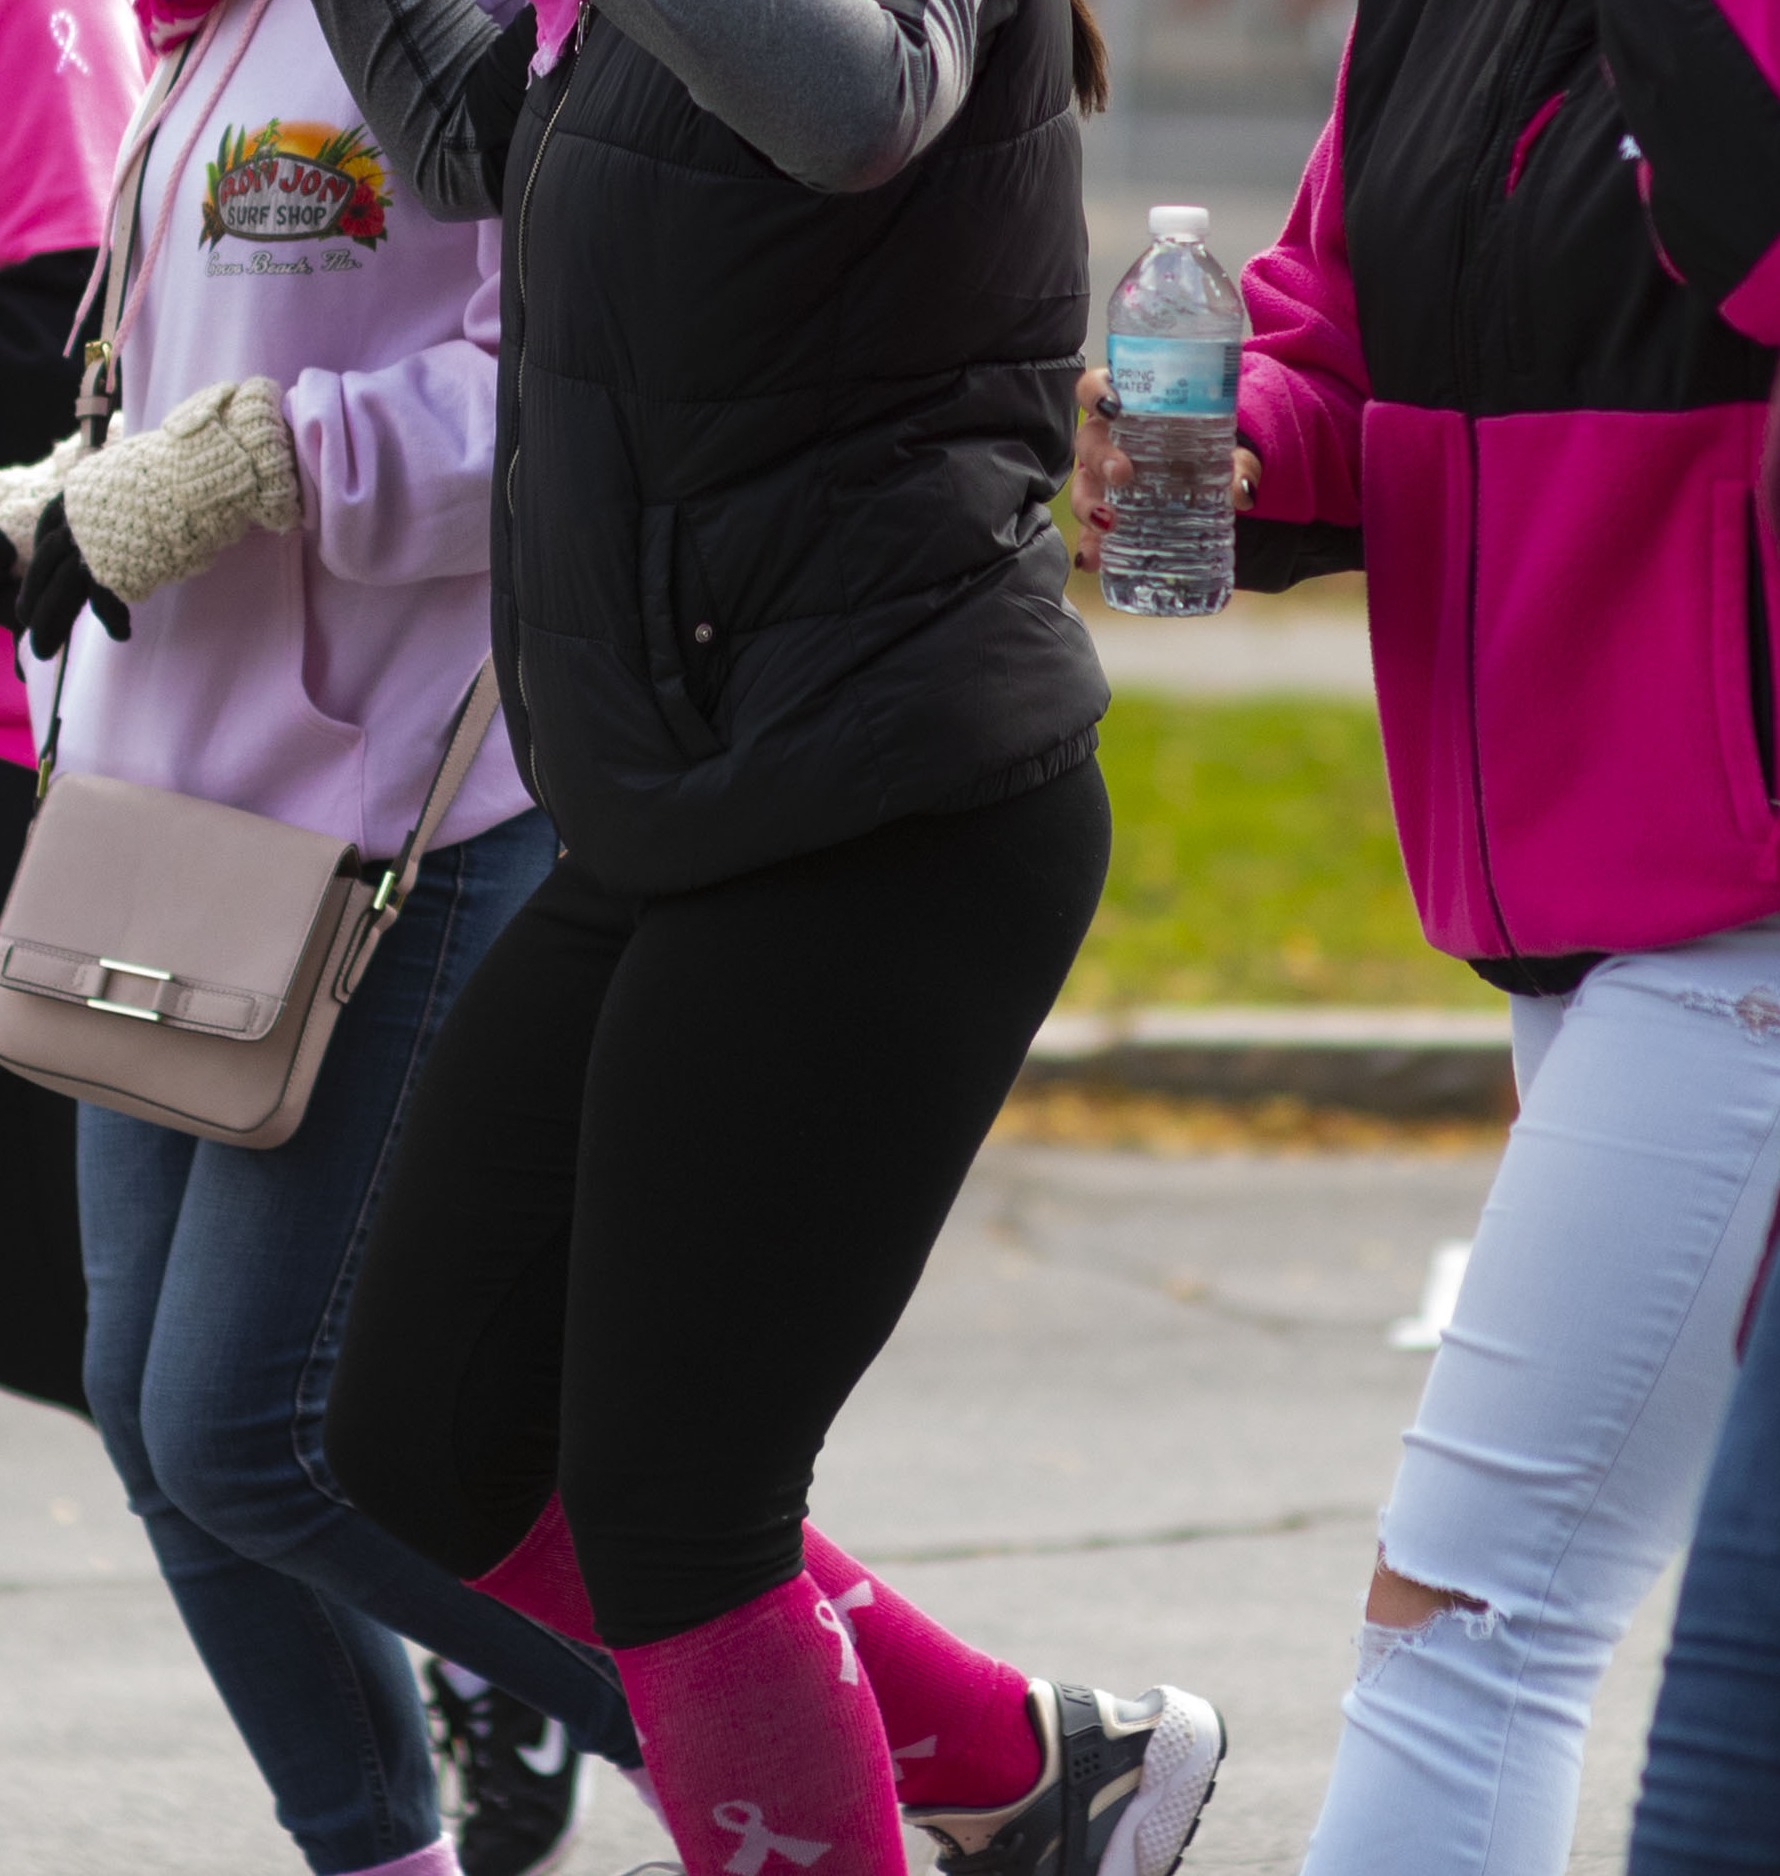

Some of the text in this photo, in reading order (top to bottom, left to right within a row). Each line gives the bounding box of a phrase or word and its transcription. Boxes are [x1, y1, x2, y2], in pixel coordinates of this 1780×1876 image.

[221, 160, 349, 205] RON JON
[227, 205, 327, 226] SURF SHOP
[1116, 367, 1155, 382] SPRING
